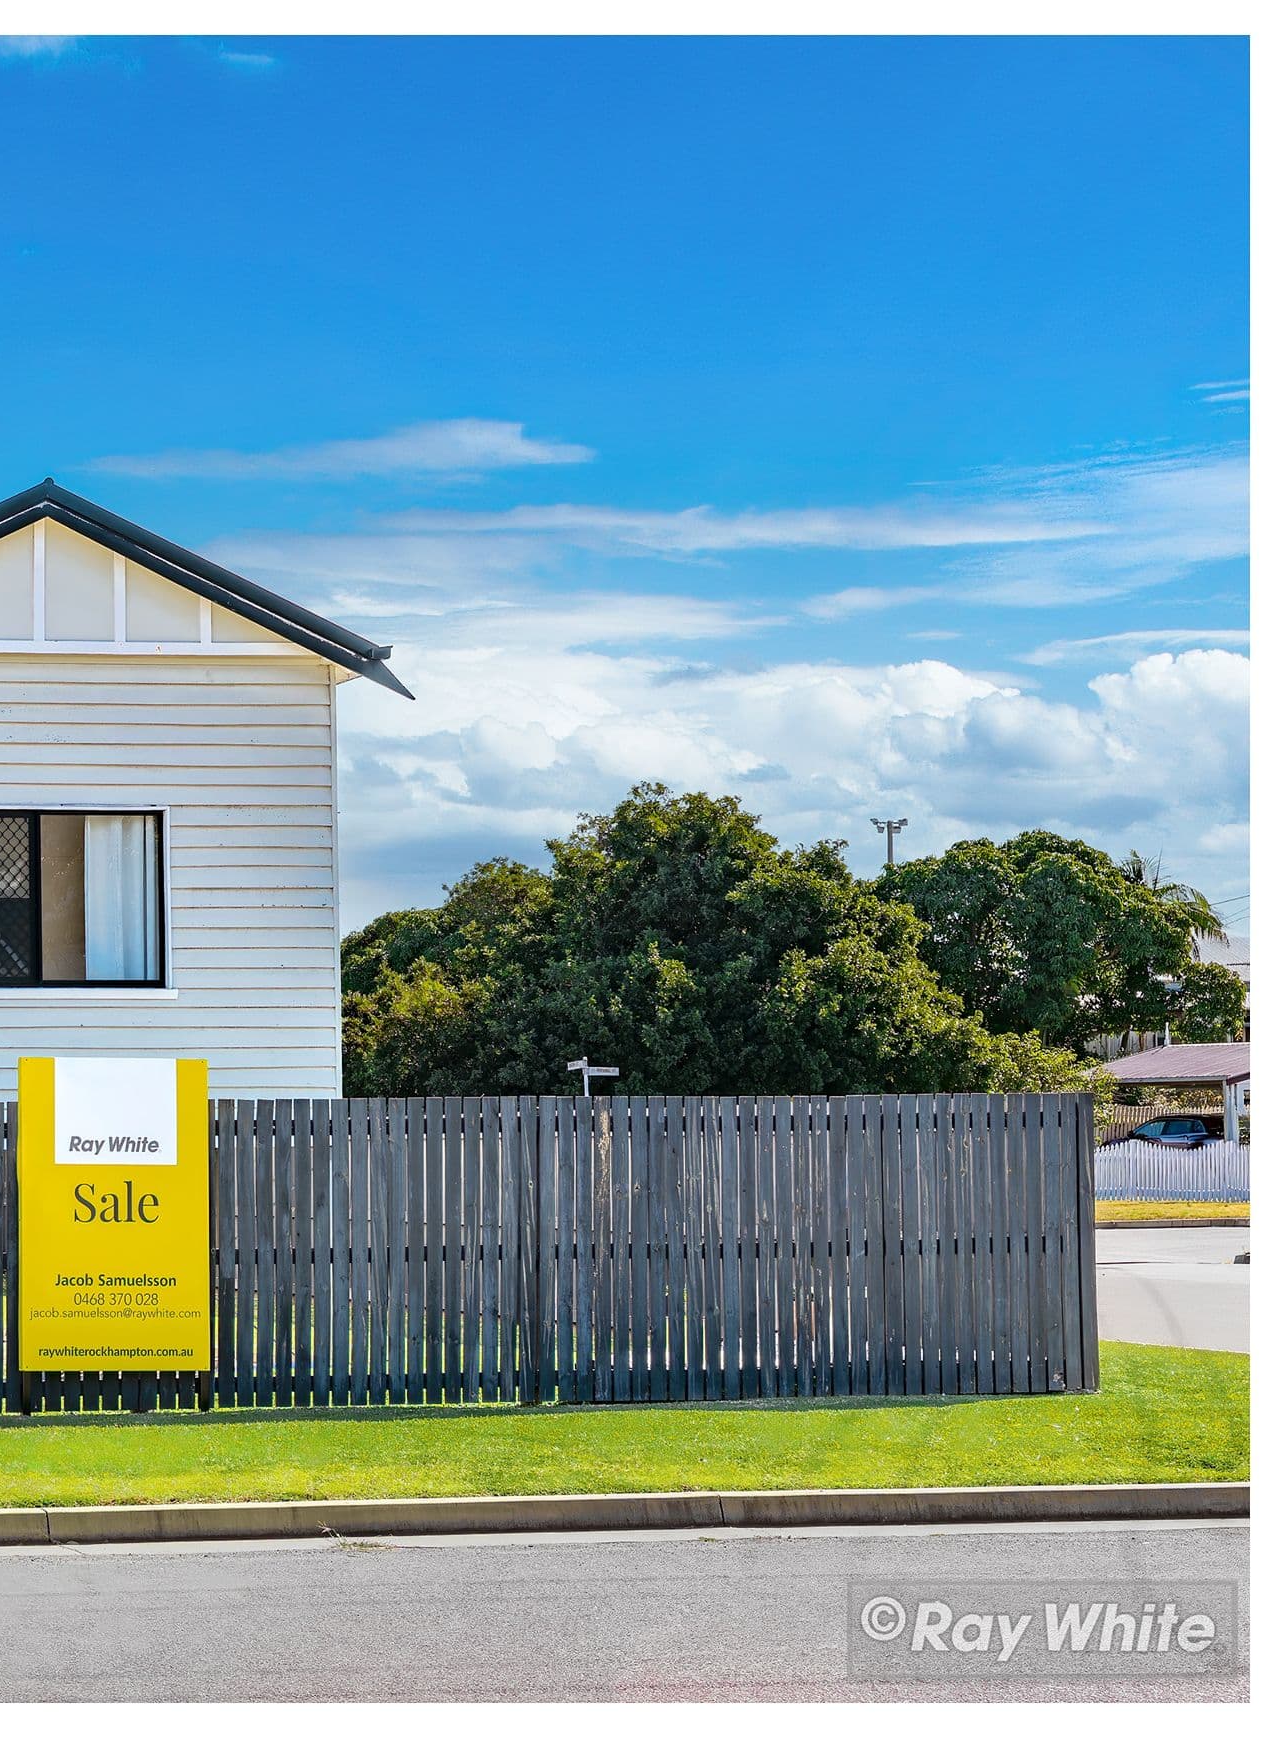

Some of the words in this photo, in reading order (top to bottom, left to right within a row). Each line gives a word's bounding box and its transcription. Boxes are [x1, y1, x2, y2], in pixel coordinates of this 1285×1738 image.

[69, 1136, 106, 1156] Ray
[108, 1136, 160, 1153] White
[74, 1181, 159, 1223] Sale
[55, 1273, 94, 1287] Jacob
[98, 1273, 177, 1287] Samuelsson
[74, 1293, 105, 1306] 0468
[109, 1293, 132, 1306] 370
[135, 1293, 159, 1306] 028
[29, 1307, 201, 1320] jacob.samuelsson@raywhite.com
[38, 1345, 194, 1358] raywhiterockhampton.com.au
